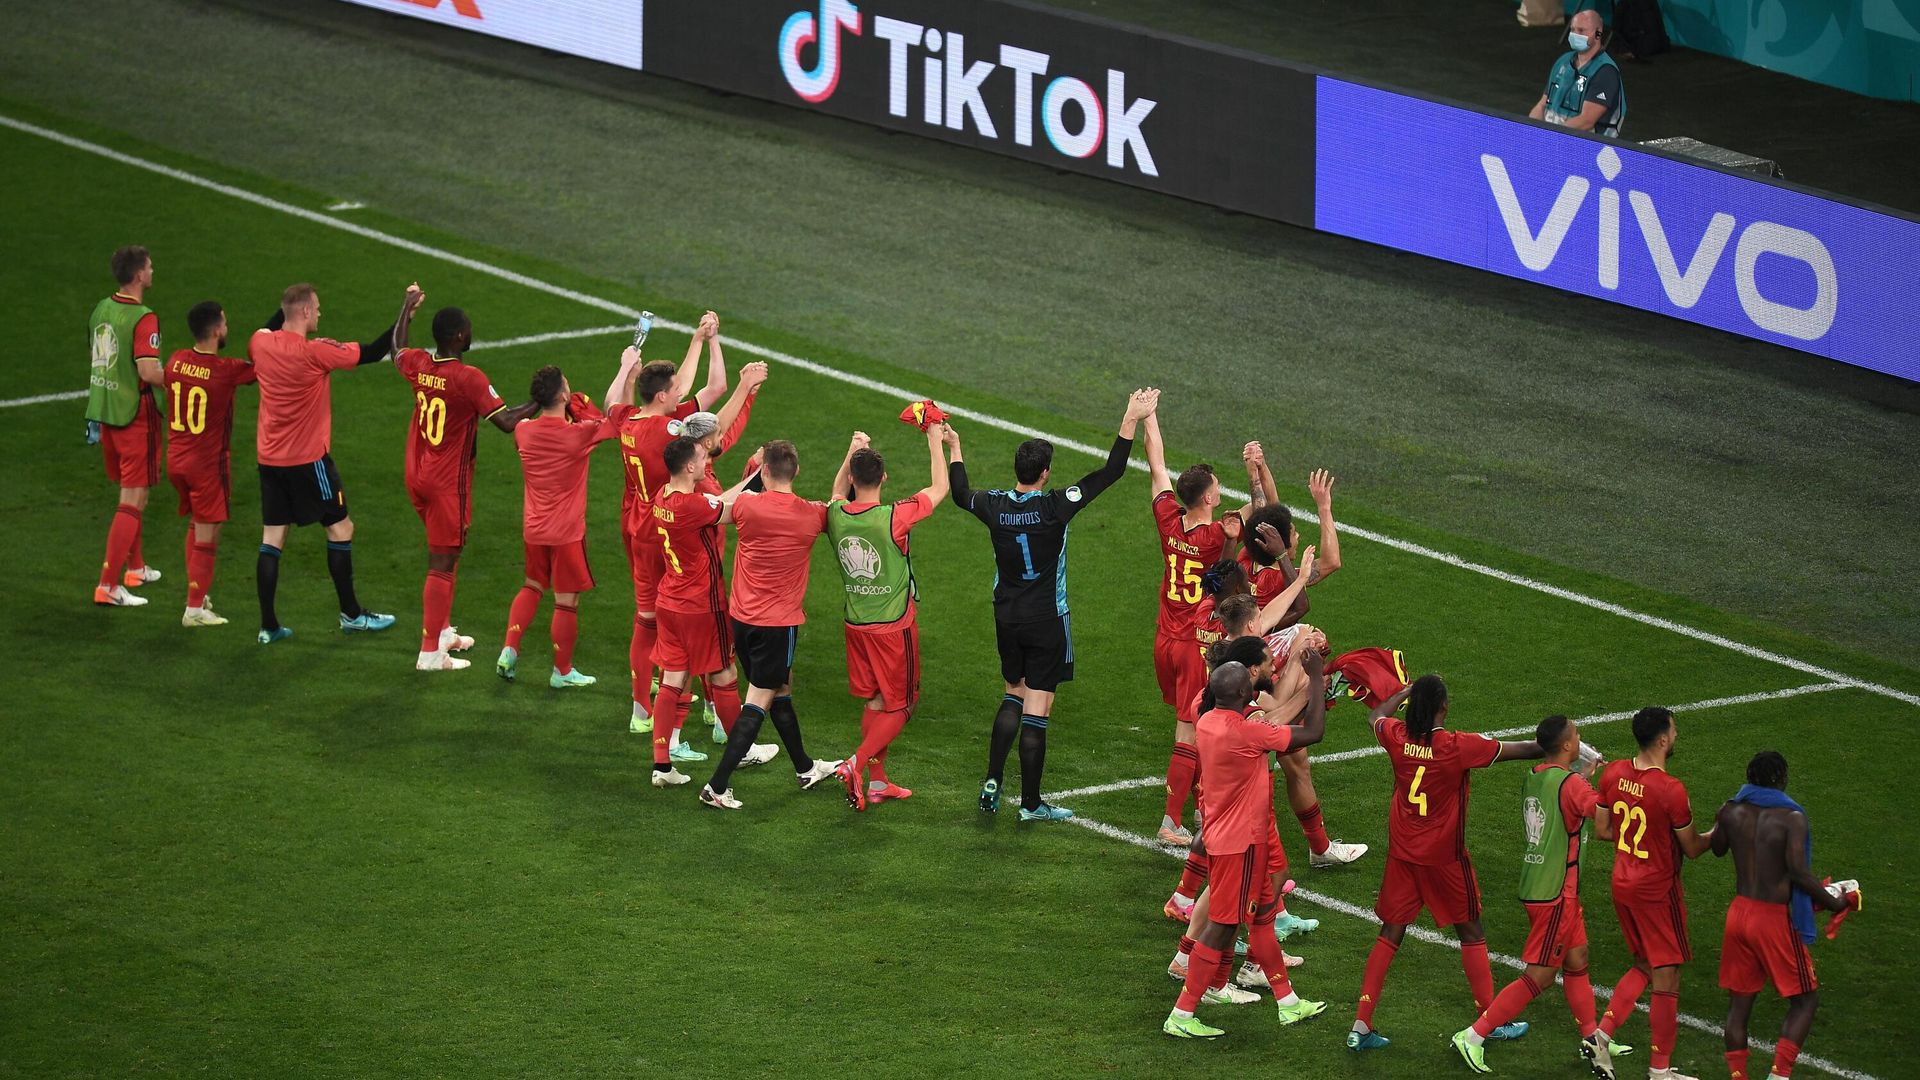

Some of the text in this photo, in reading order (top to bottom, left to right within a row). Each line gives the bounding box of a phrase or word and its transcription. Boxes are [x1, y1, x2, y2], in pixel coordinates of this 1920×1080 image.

[873, 15, 1160, 177] TikTok
[1480, 146, 1838, 341] vivo
[181, 362, 211, 380] HAZARD
[417, 372, 447, 391] BENTEKE
[170, 381, 208, 435] 10
[999, 511, 1041, 526] COURTOIS
[1015, 533, 1041, 580] 1
[1167, 536, 1200, 556] MEUNIER
[1167, 553, 1204, 605] 15
[1408, 765, 1428, 817] 4
[1612, 800, 1649, 859] 22
